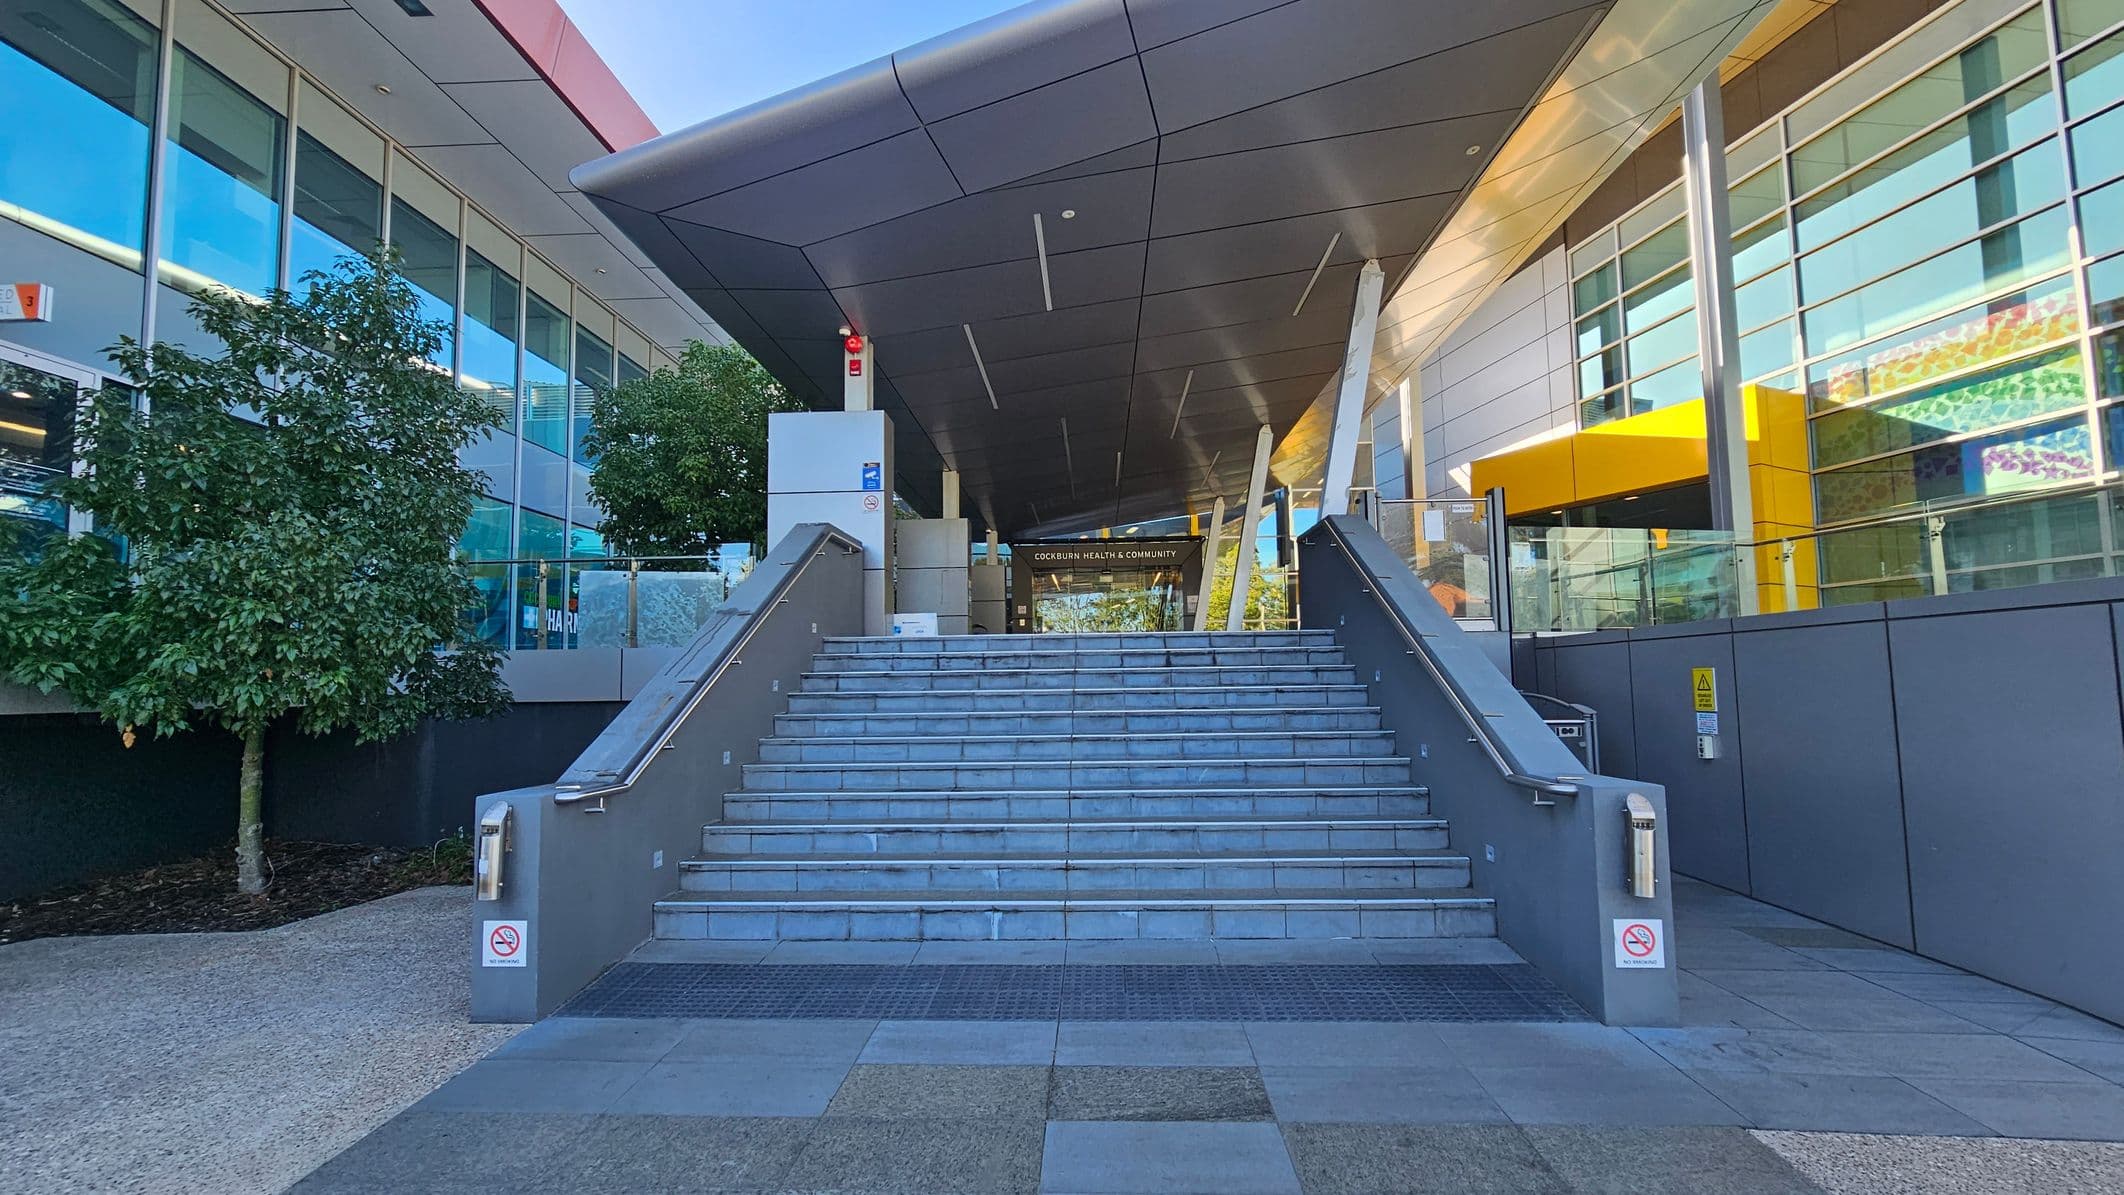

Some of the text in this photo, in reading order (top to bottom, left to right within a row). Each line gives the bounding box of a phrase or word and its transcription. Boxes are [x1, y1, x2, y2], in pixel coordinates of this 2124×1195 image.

[26, 295, 34, 307] 3
[1034, 550, 1177, 560] COCKBURN HEALTH & COMMUNITY
